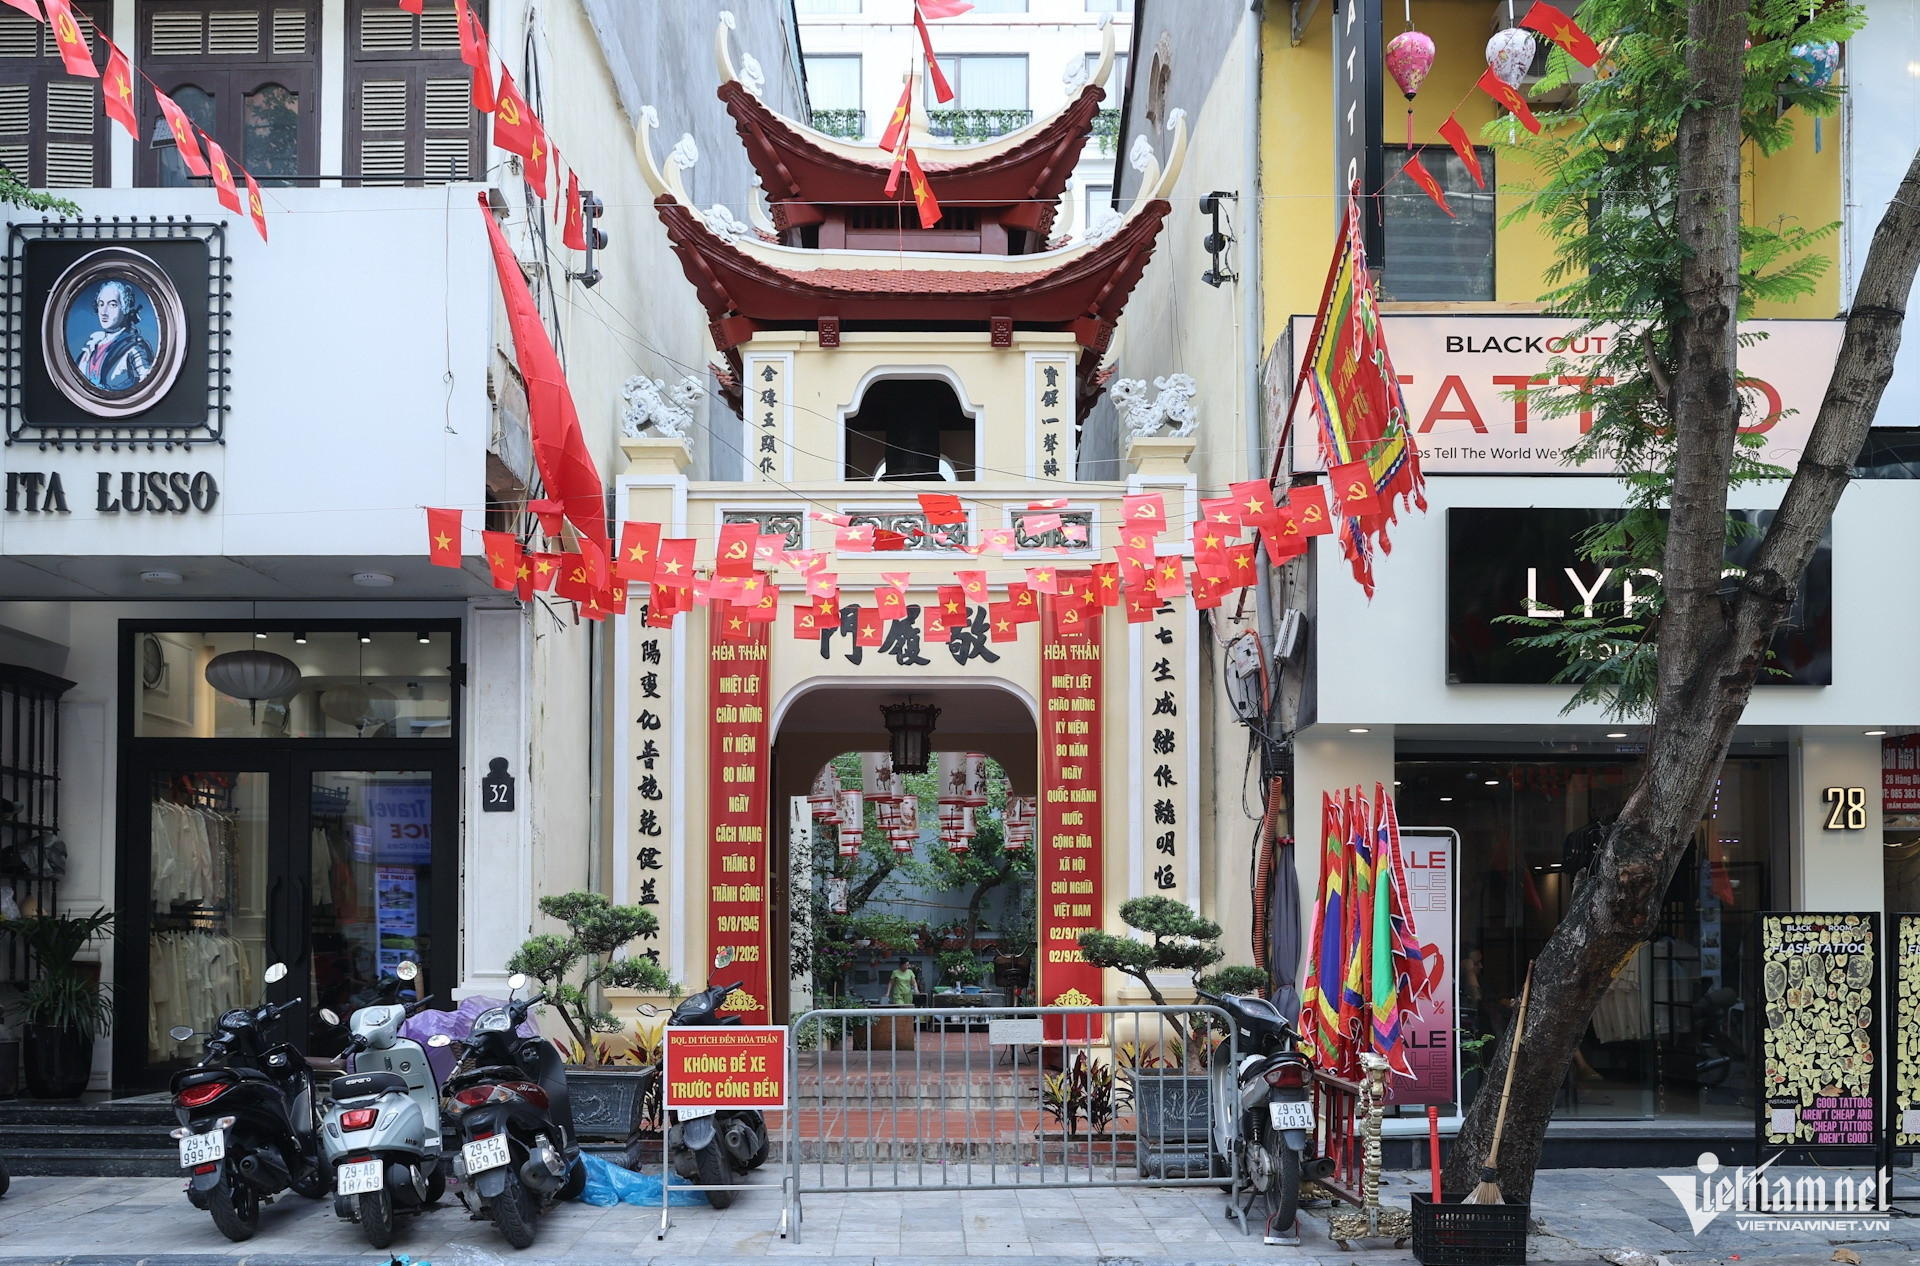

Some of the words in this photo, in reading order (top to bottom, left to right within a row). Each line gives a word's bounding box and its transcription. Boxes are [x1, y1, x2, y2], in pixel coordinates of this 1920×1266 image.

[1446, 336, 1608, 354] BLACKOUT
[1397, 375, 1782, 435] ATTO
[1434, 447, 1457, 460] Tell
[1461, 447, 1487, 460] The
[1490, 447, 1531, 460] World
[4, 471, 72, 514] ITA
[95, 471, 219, 514] LUSSO
[738, 639, 767, 661] THẦN
[1070, 638, 1100, 661] THẦN
[719, 674, 742, 696] NHIỆT
[744, 674, 760, 696] LIỆT
[1051, 673, 1074, 691] NHIỆT
[1075, 673, 1092, 691] LIỆT
[1048, 696, 1070, 712] CHÀO
[1071, 696, 1096, 712] MỪNG
[716, 704, 737, 724] CHÀO
[739, 704, 763, 724] MỪNG
[1067, 719, 1089, 736] NIỆM
[735, 734, 756, 756] NIỆM
[1056, 743, 1068, 757] 80
[1069, 741, 1089, 757] NĂM
[723, 767, 735, 783] 80
[736, 763, 755, 783] NĂM
[1061, 765, 1083, 780] NGÀY
[1885, 774, 1894, 785] 28
[489, 784, 508, 803] 32
[1047, 786, 1069, 803] QUỐC
[1070, 788, 1097, 803] KHÁNH
[728, 794, 750, 813] NGÀY
[1823, 787, 1866, 830] 28
[1061, 810, 1083, 826] NƯỚC
[715, 823, 737, 843] CÁCH
[739, 826, 763, 845] MẠNG
[1052, 834, 1074, 850] CỘNG
[1075, 833, 1093, 848] HÒA
[722, 853, 748, 873] THÁNG
[749, 856, 756, 873] 8
[1059, 856, 1071, 872] XÃ
[1072, 857, 1086, 873] HỘI
[712, 883, 738, 902] THÀNH
[1051, 878, 1068, 895] CHỦ
[1069, 880, 1094, 895] NGHĨA
[1053, 902, 1071, 919] VIỆT
[1072, 904, 1092, 918] NAM
[717, 915, 760, 933] 19/8/1945
[1828, 924, 1852, 932] ROOM
[671, 1036, 688, 1046] BQL
[688, 1036, 698, 1044] DI
[698, 1034, 718, 1045] TÍCH
[683, 1053, 727, 1073] KHÔNG
[730, 1049, 747, 1073] ĐỂ
[749, 1056, 766, 1073] XE
[671, 1078, 713, 1099] TRƯỚC
[715, 1075, 750, 1098] CỔNG
[1276, 1103, 1307, 1115] 29-G1
[1816, 1097, 1837, 1109] GOOD
[1839, 1097, 1873, 1109] TATTOOS
[1275, 1115, 1313, 1128] 340.34
[1802, 1109, 1829, 1121] AREN'T
[1831, 1109, 1855, 1121] CHEAP
[1856, 1109, 1873, 1121] AND
[1813, 1120, 1838, 1132] CHEAP
[1839, 1120, 1873, 1132] TATTOOS
[186, 1133, 217, 1151] 29-K1
[1818, 1132, 1846, 1144] AREN'T
[1847, 1132, 1868, 1144] GOOD
[183, 1145, 221, 1165] 999.70
[468, 1150, 507, 1172] 059.18
[344, 1163, 376, 1179] 29-AB
[342, 1176, 380, 1193] 187.69
